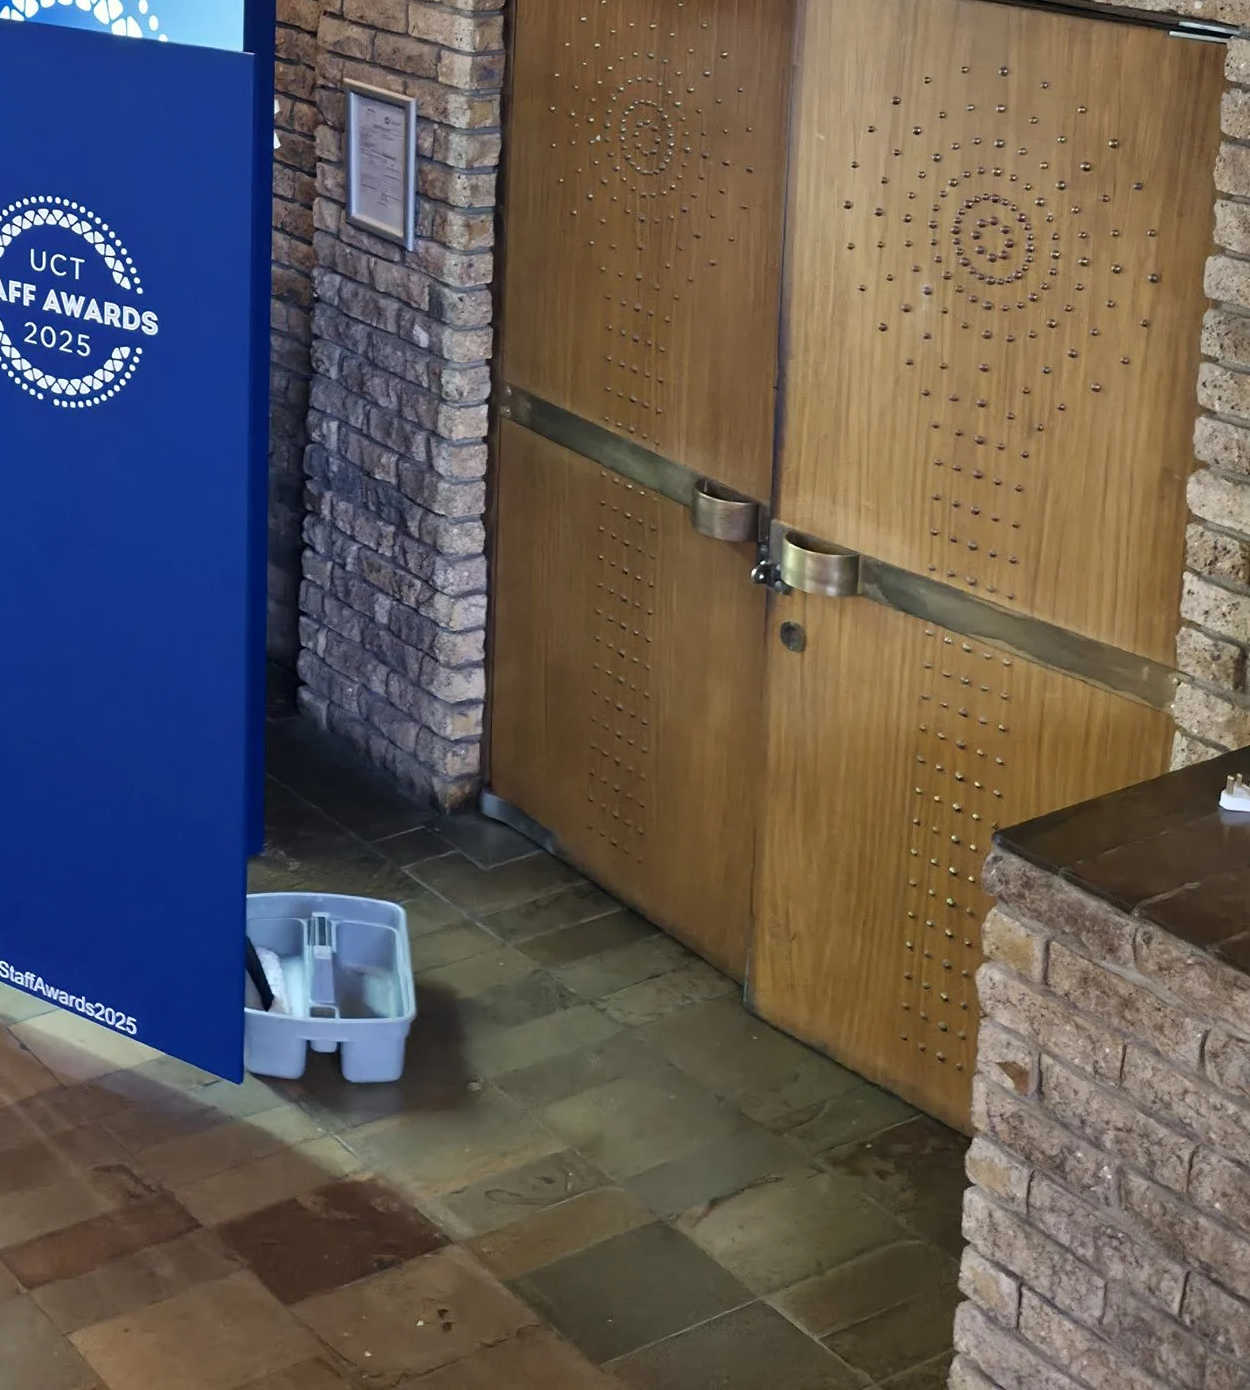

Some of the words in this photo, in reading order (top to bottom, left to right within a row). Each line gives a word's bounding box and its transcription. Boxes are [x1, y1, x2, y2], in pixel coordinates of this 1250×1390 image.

[29, 248, 86, 280] UCT
[41, 288, 159, 336] AWARDS
[23, 321, 91, 357] 2025
